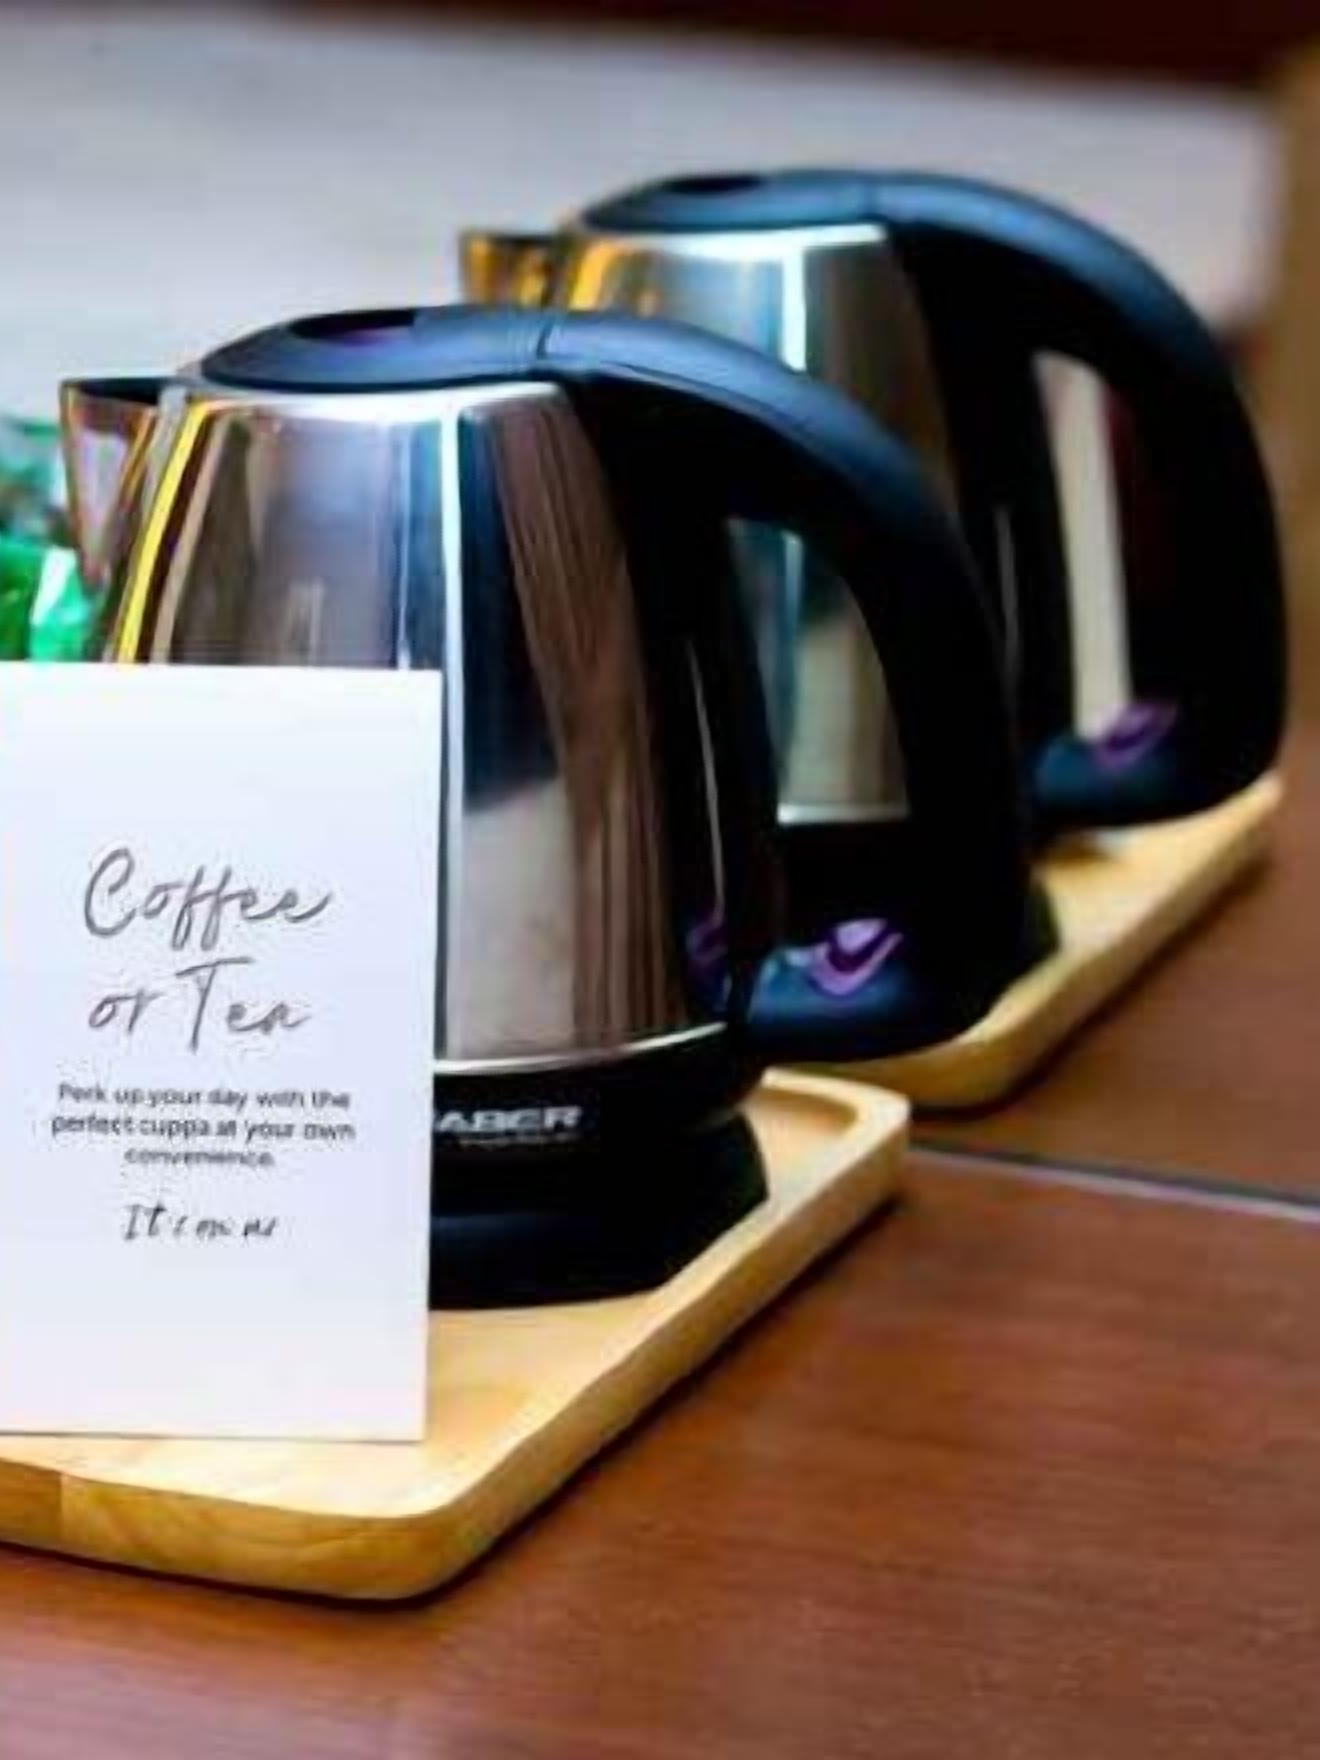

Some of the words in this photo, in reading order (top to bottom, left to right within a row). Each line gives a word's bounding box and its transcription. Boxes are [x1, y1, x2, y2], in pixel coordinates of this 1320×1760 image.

[84, 848, 334, 951] Coffee
[88, 987, 165, 1035] or
[174, 956, 313, 1055] Tea
[148, 1089, 201, 1108] your
[207, 1088, 247, 1113] day
[256, 1090, 305, 1108] with
[310, 1090, 351, 1109] the
[51, 1114, 133, 1137] perfect
[139, 1118, 210, 1140] cuppa
[214, 1119, 237, 1137] at
[244, 1120, 296, 1144] your
[302, 1122, 356, 1141] own
[436, 1105, 582, 1133] ABER
